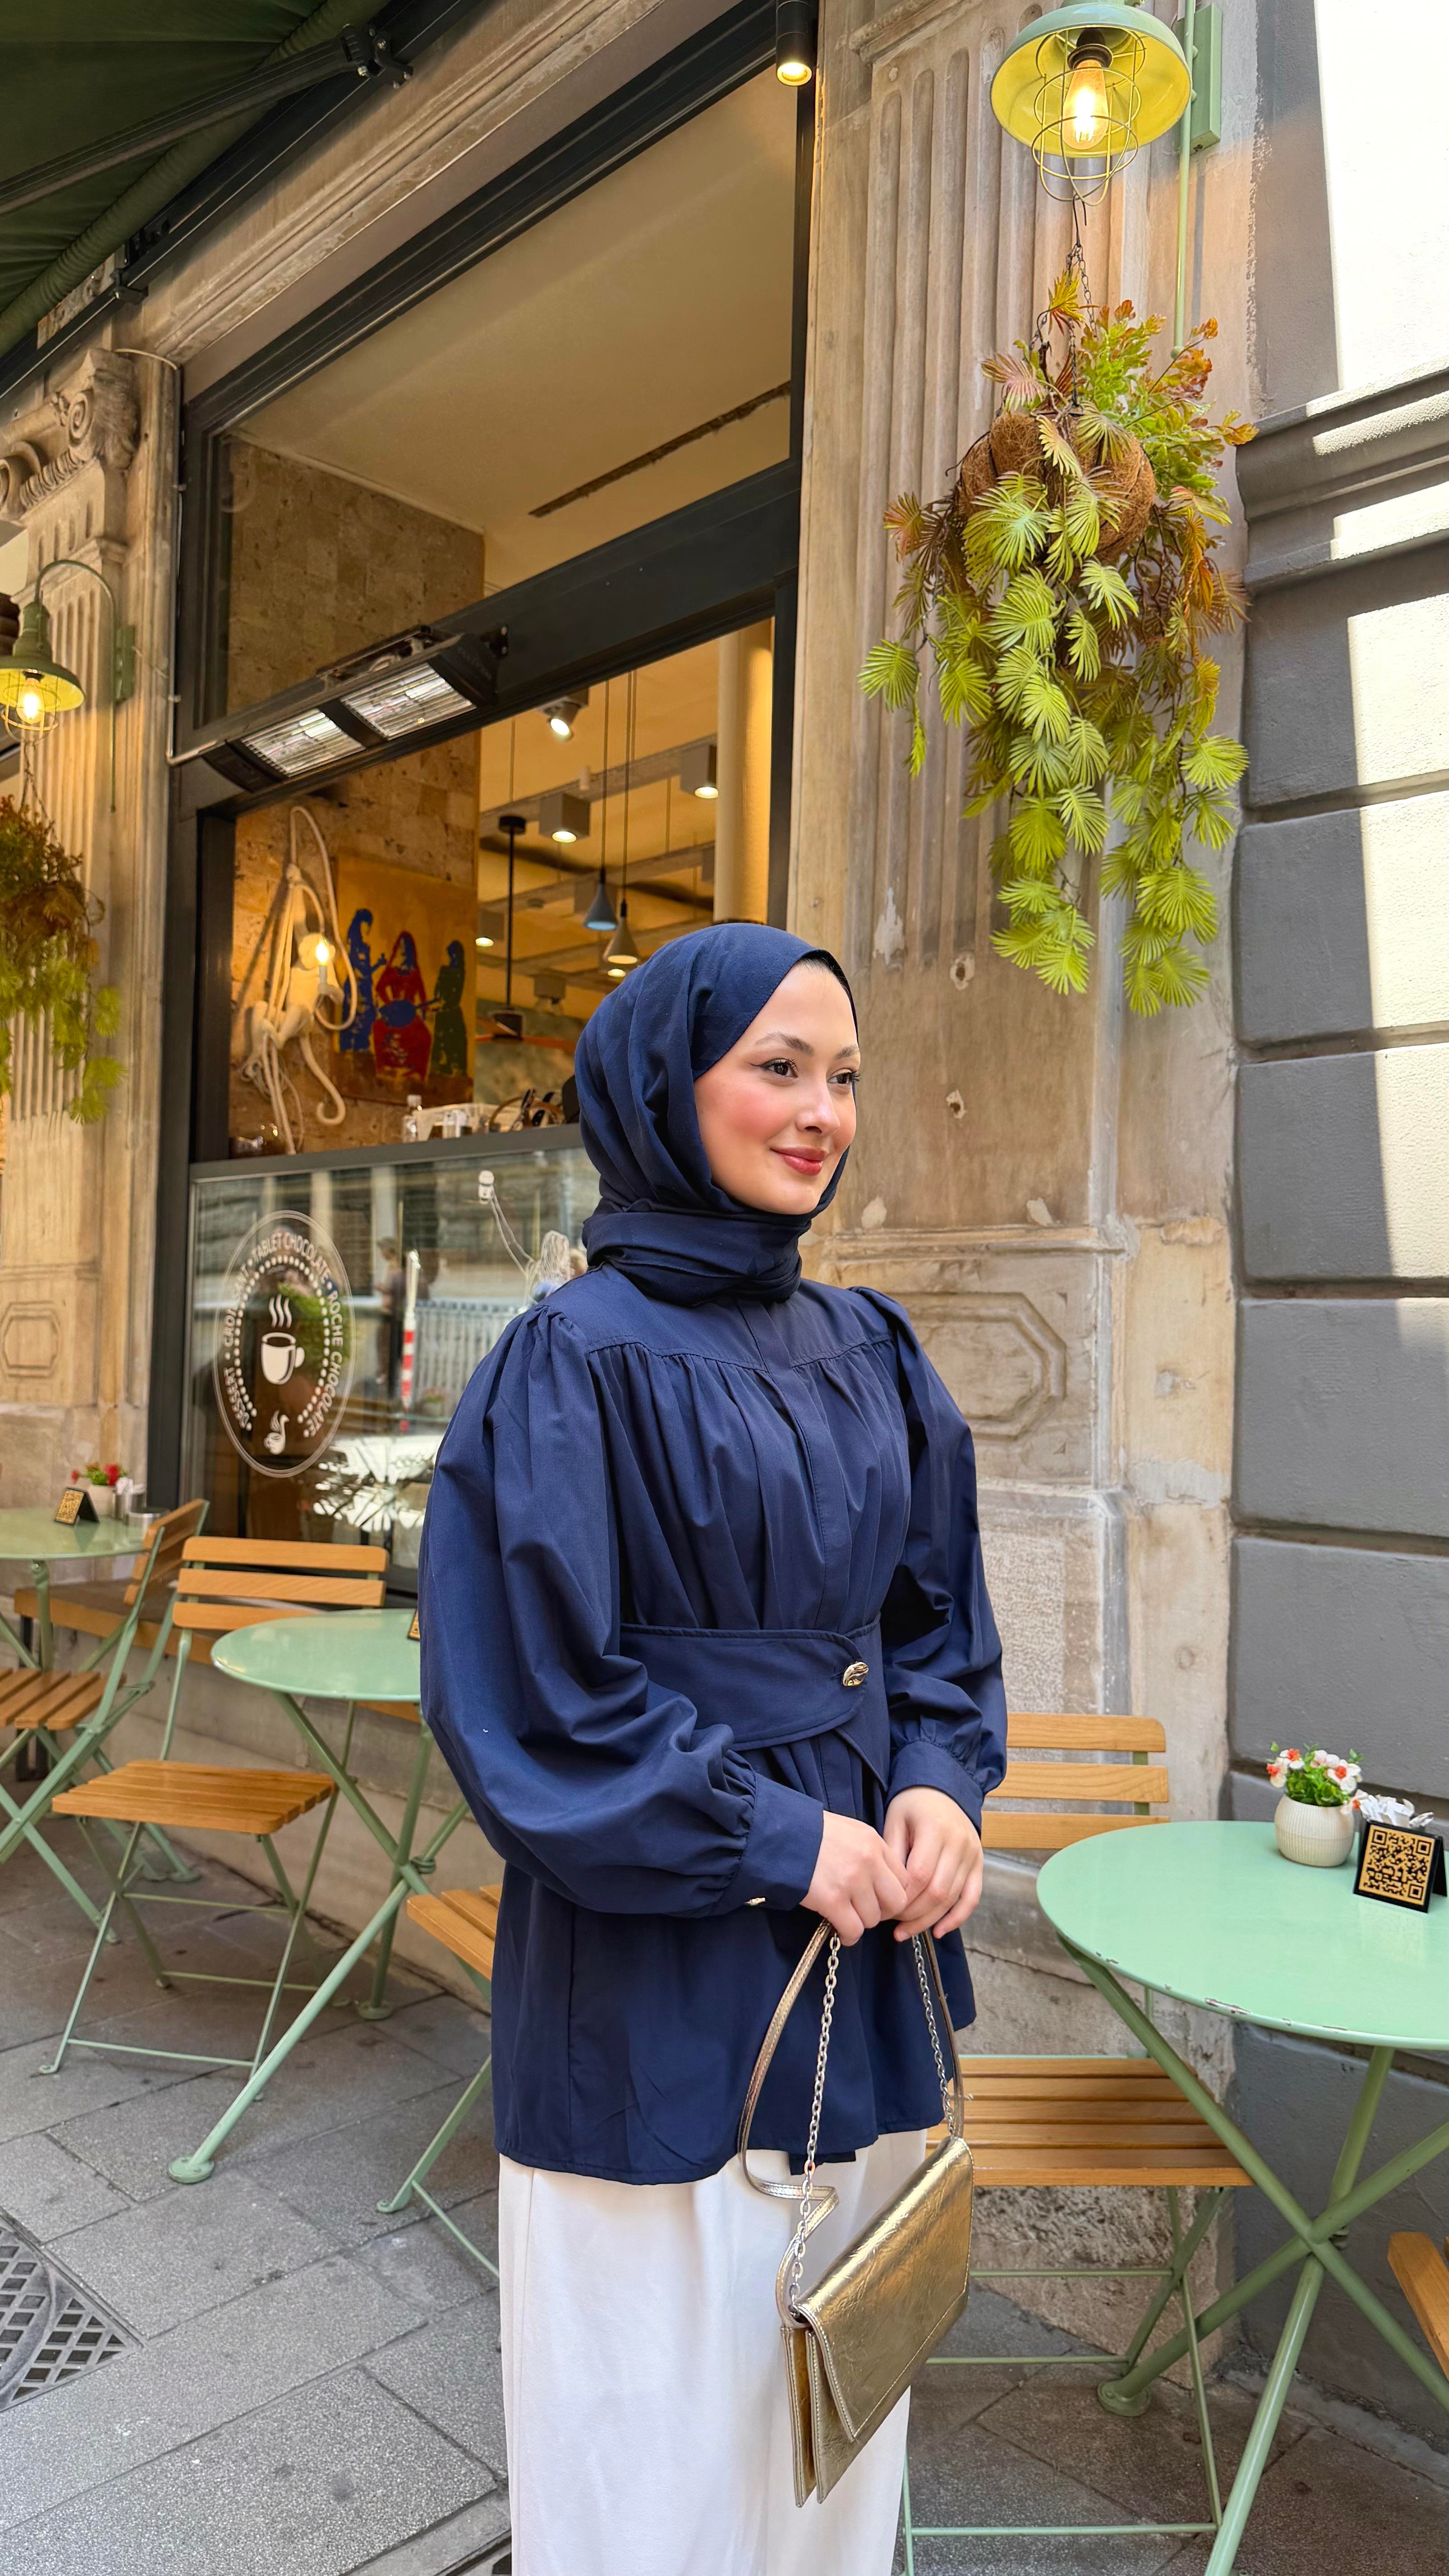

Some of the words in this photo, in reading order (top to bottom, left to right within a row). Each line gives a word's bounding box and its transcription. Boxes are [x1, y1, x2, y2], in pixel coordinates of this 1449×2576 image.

[250, 1232, 283, 1262] TABLET
[283, 1232, 331, 1284] CHOCOLATE
[222, 1263, 249, 1348] CROISANT
[328, 1290, 344, 1347] ROCHE
[223, 1367, 250, 1429] DESSERT
[306, 1351, 343, 1437] CHOCOLATE
